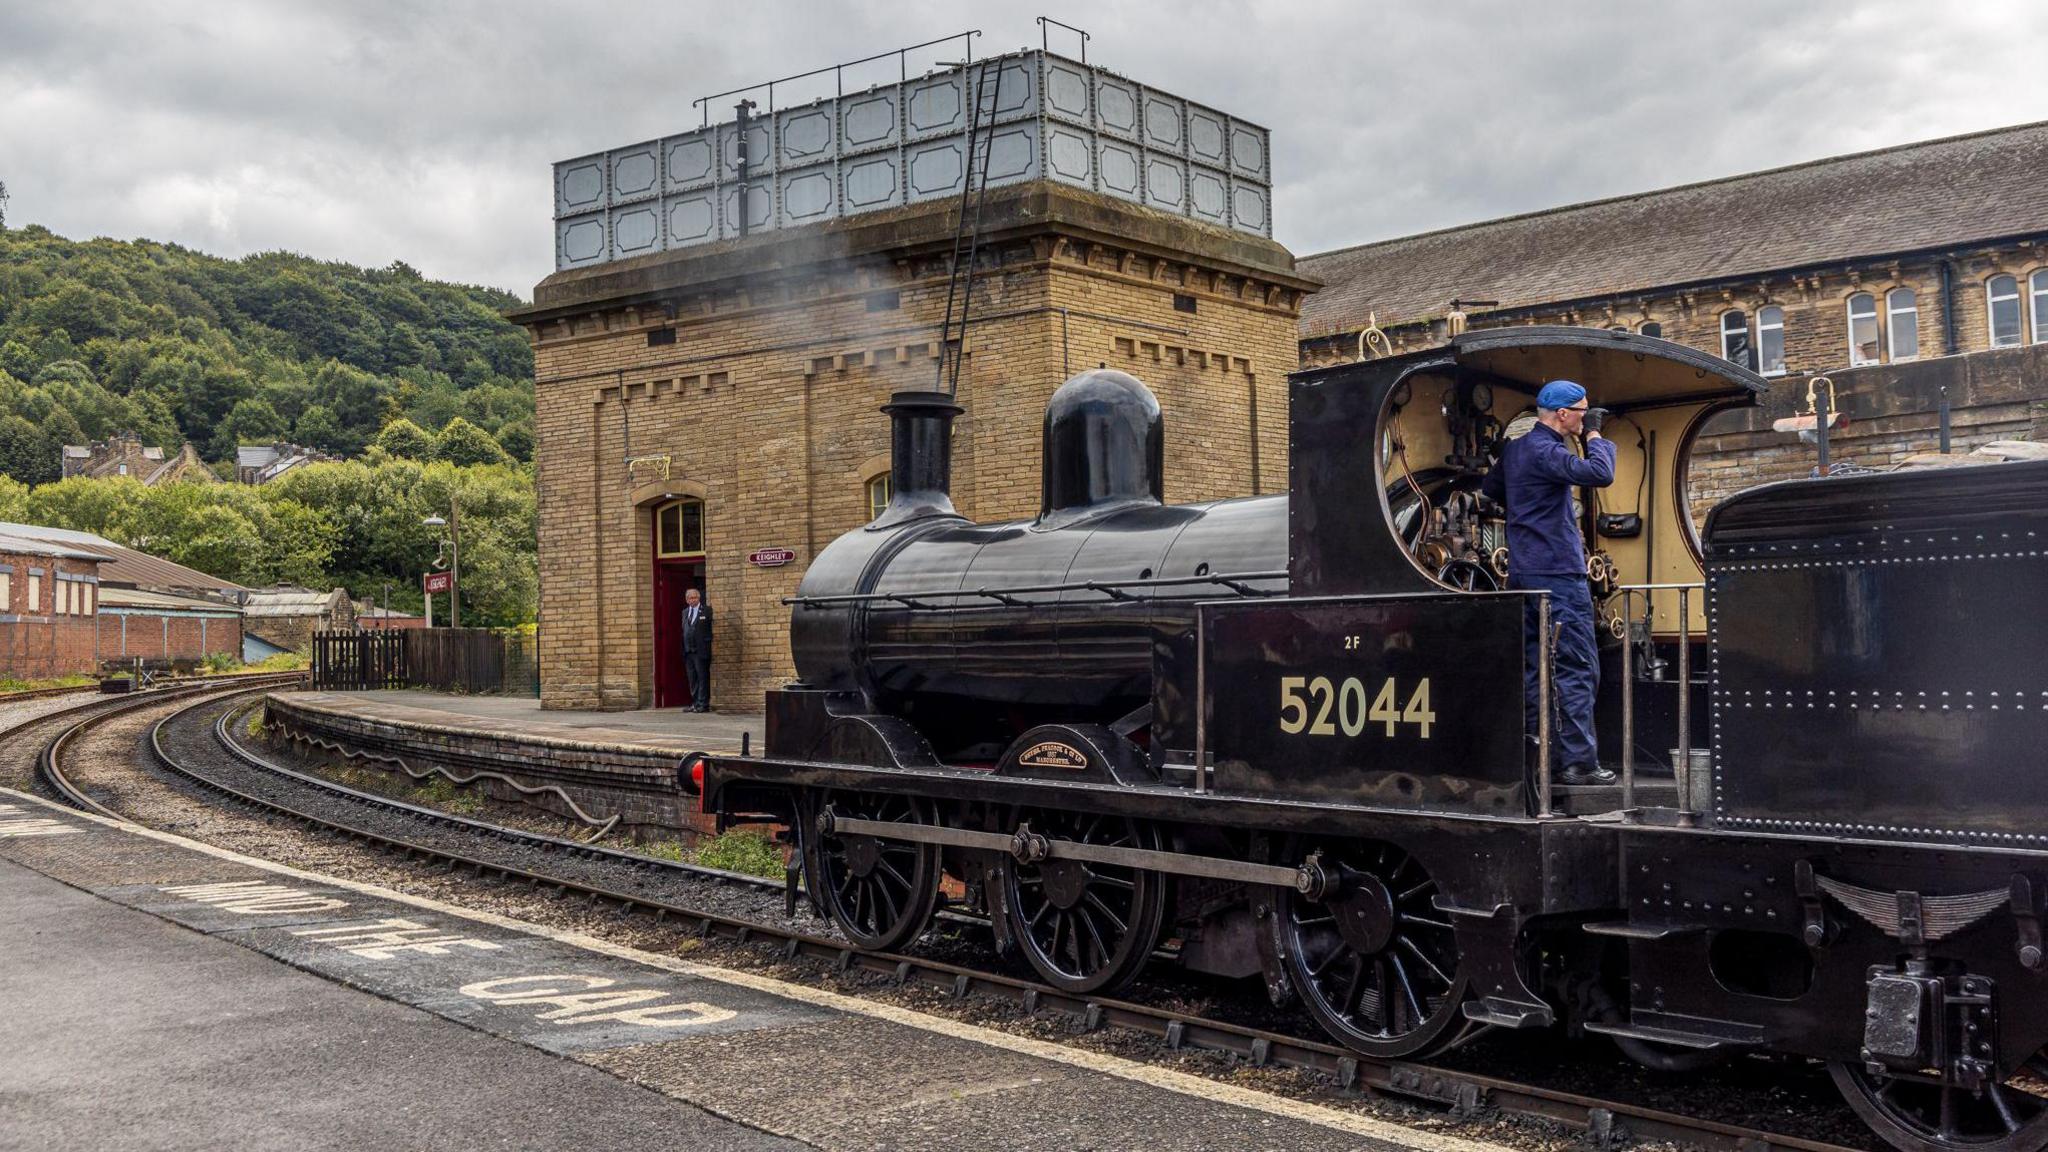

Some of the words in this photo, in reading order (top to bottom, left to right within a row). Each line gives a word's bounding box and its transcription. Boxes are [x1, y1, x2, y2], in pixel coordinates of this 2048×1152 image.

[1344, 636, 1360, 649] 2F
[1280, 676, 1436, 739] 52044
[157, 880, 351, 914] MIND
[292, 918, 503, 961] THE
[459, 974, 738, 1028] GAP
